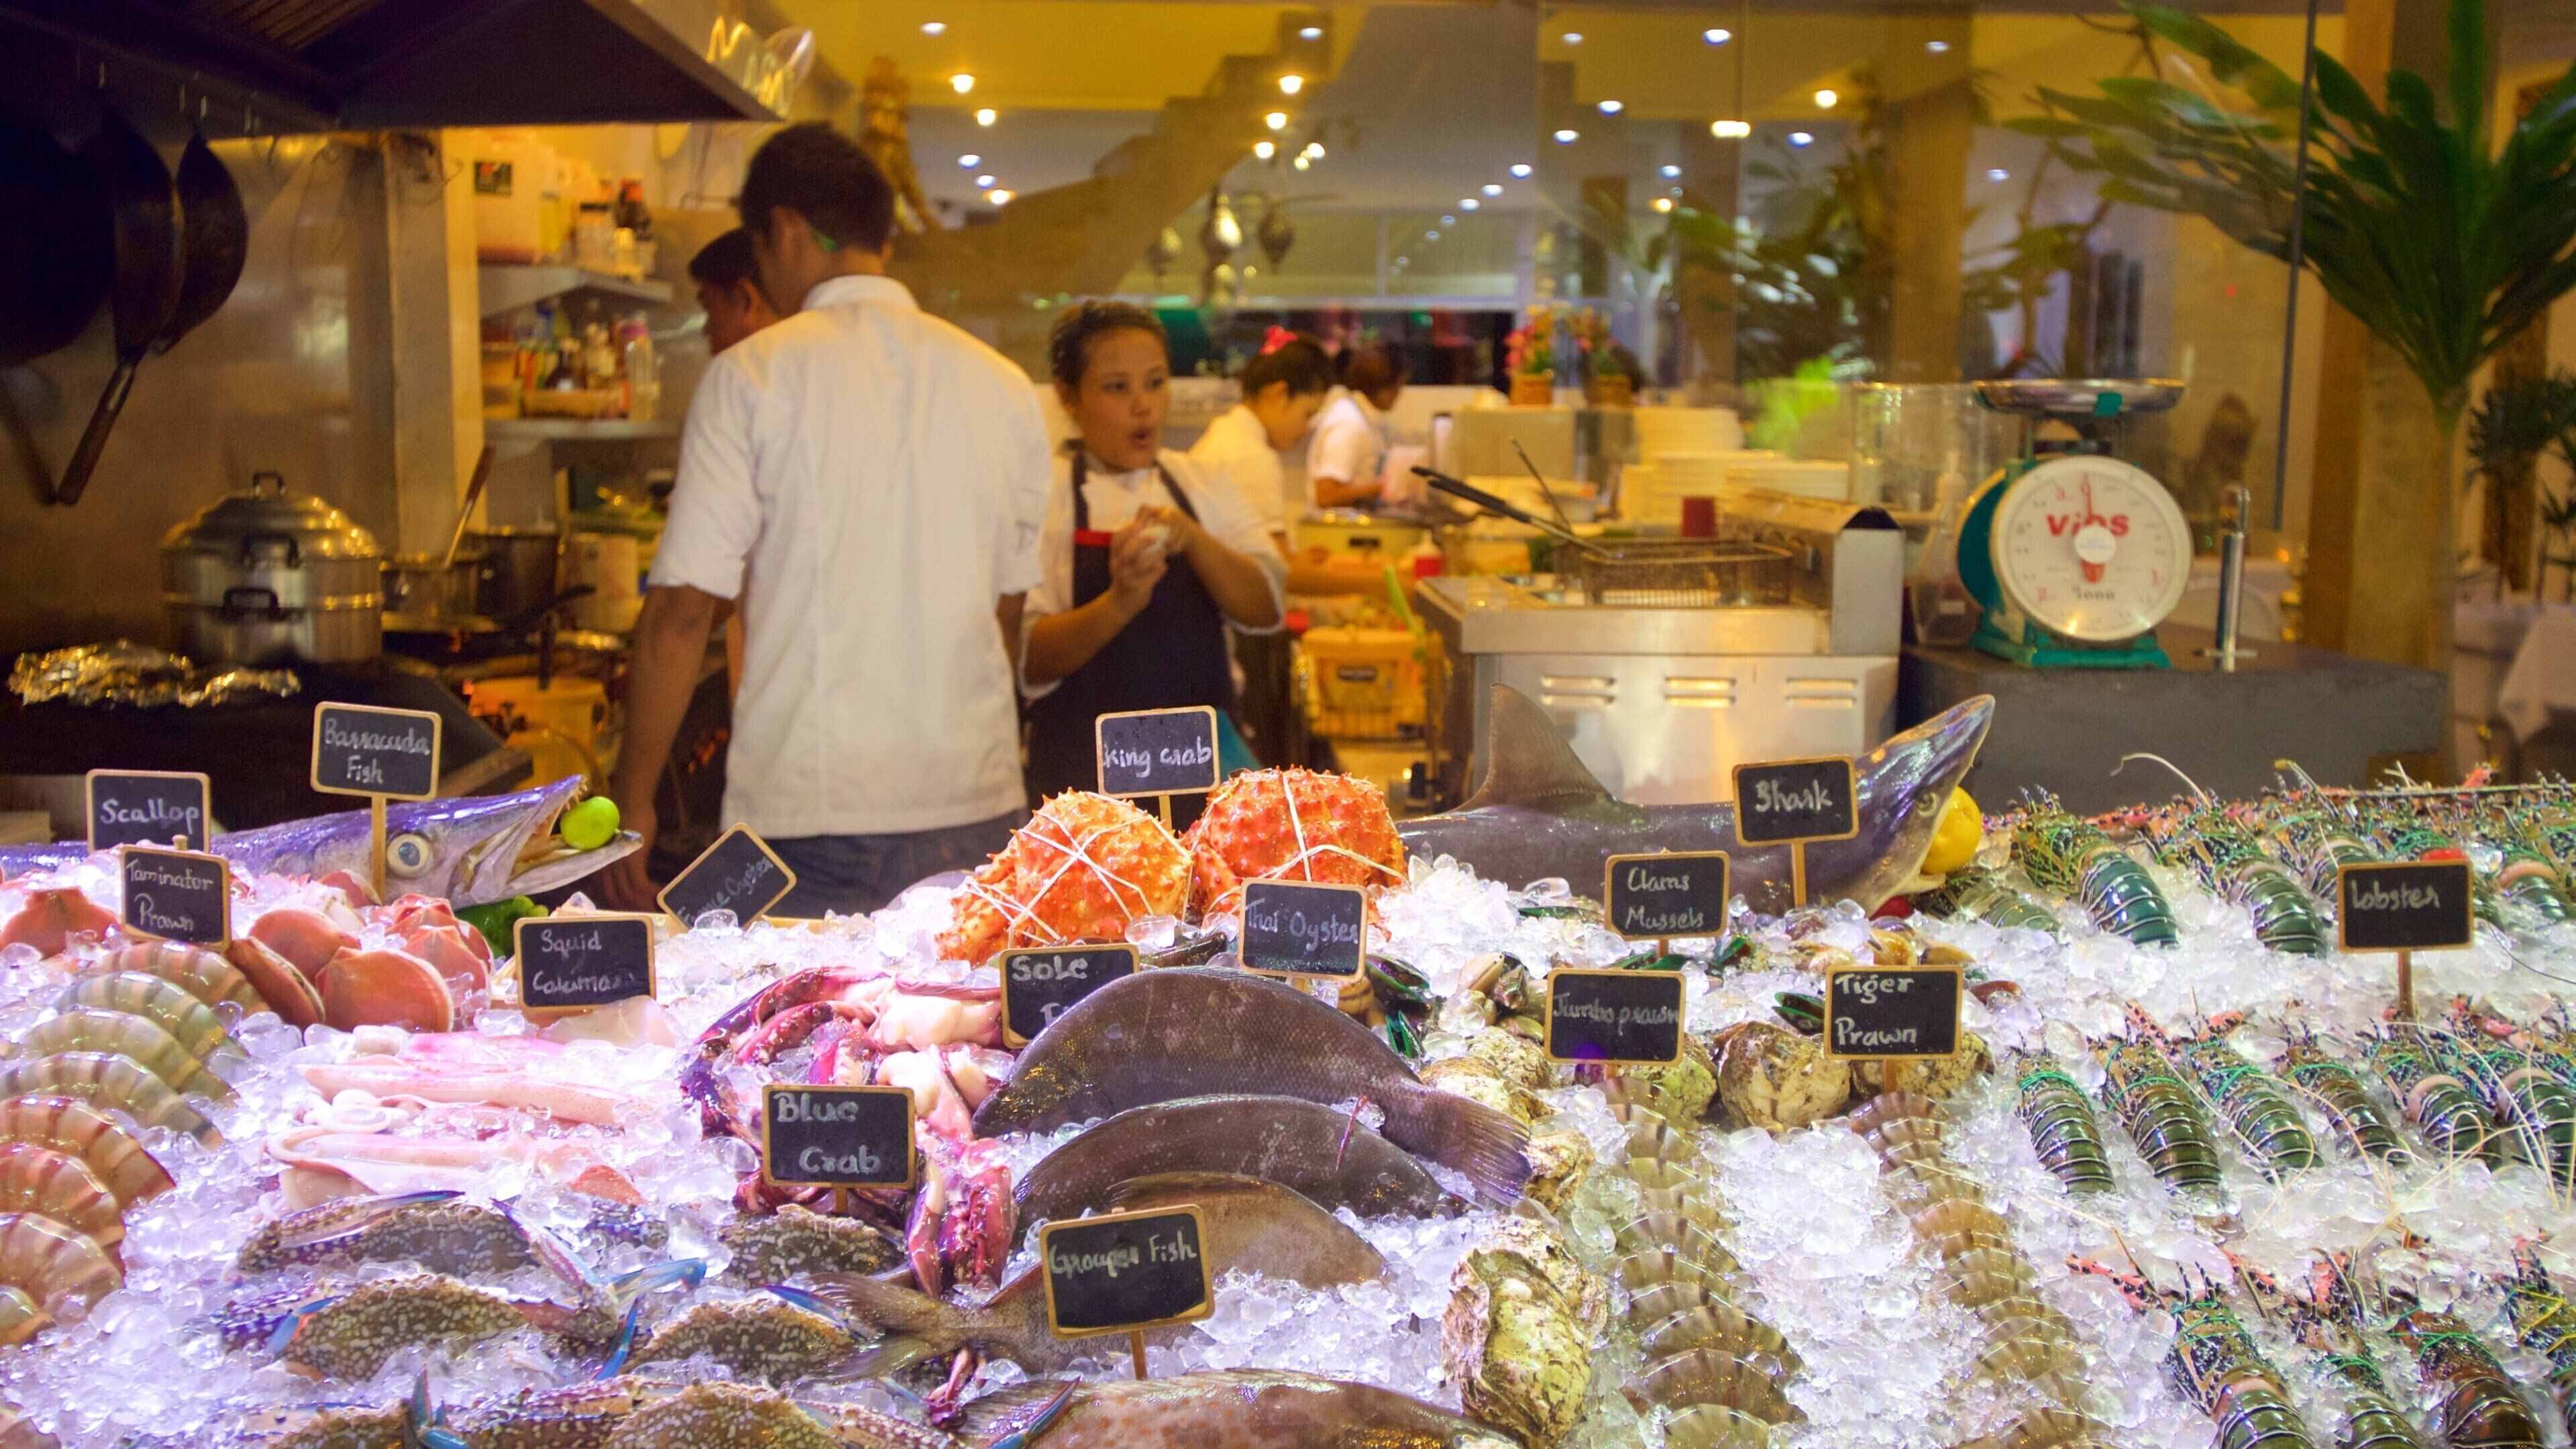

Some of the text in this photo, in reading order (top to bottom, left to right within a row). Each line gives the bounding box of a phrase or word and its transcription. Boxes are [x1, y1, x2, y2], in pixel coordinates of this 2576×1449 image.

[325, 718, 430, 755] Barracuda
[1160, 735, 1212, 766] crab
[347, 755, 383, 784] Fish
[1755, 779, 1833, 812] Shark
[100, 798, 199, 835] Scallop
[125, 858, 214, 890] Taminator
[1627, 867, 1690, 892] Clams
[134, 893, 193, 931] Prawn
[1246, 898, 1358, 951] Thai Oyster
[1625, 906, 1704, 930] Mussels
[541, 929, 602, 961] Squid
[1835, 973, 1914, 1004] Tiger
[1553, 991, 1680, 1036] Jumbo prawn
[1835, 1017, 1917, 1046] Prawn
[773, 1092, 859, 1122] Blue
[798, 1144, 881, 1174] Crab
[1149, 1228, 1197, 1263] Fish
